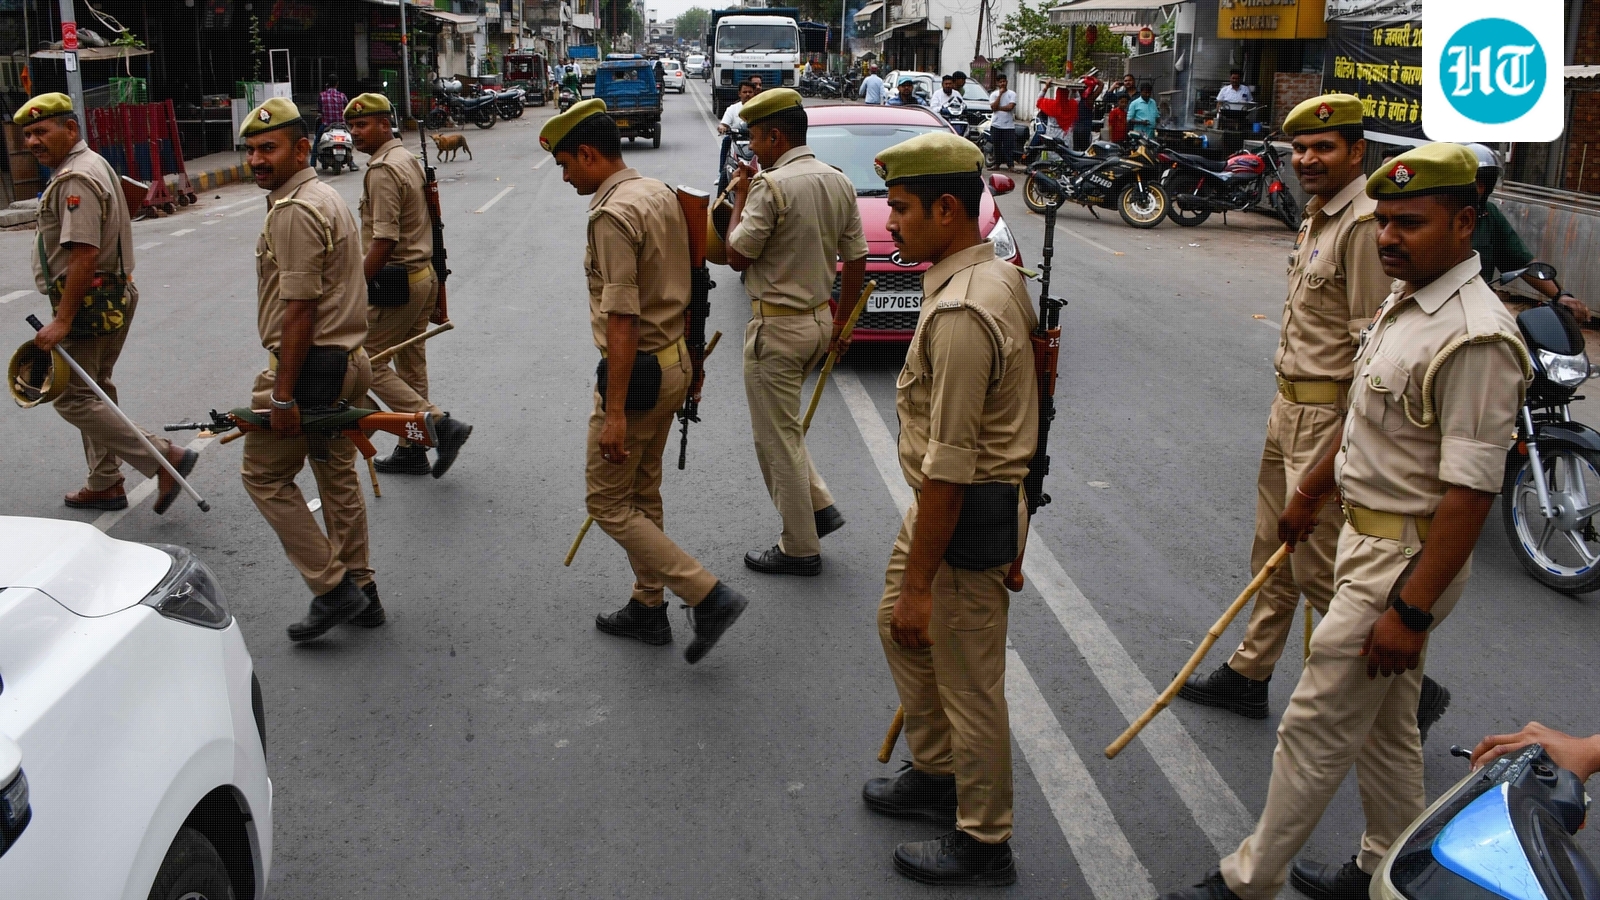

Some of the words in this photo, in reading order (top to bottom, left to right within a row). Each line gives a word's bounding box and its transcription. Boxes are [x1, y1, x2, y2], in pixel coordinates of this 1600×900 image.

[1373, 28, 1383, 46] 16
[1385, 22, 1411, 47] जनवरी
[1390, 59, 1400, 84] के
[1378, 95, 1388, 119] के
[1388, 96, 1409, 122] बंगले
[1409, 99, 1419, 124] के
